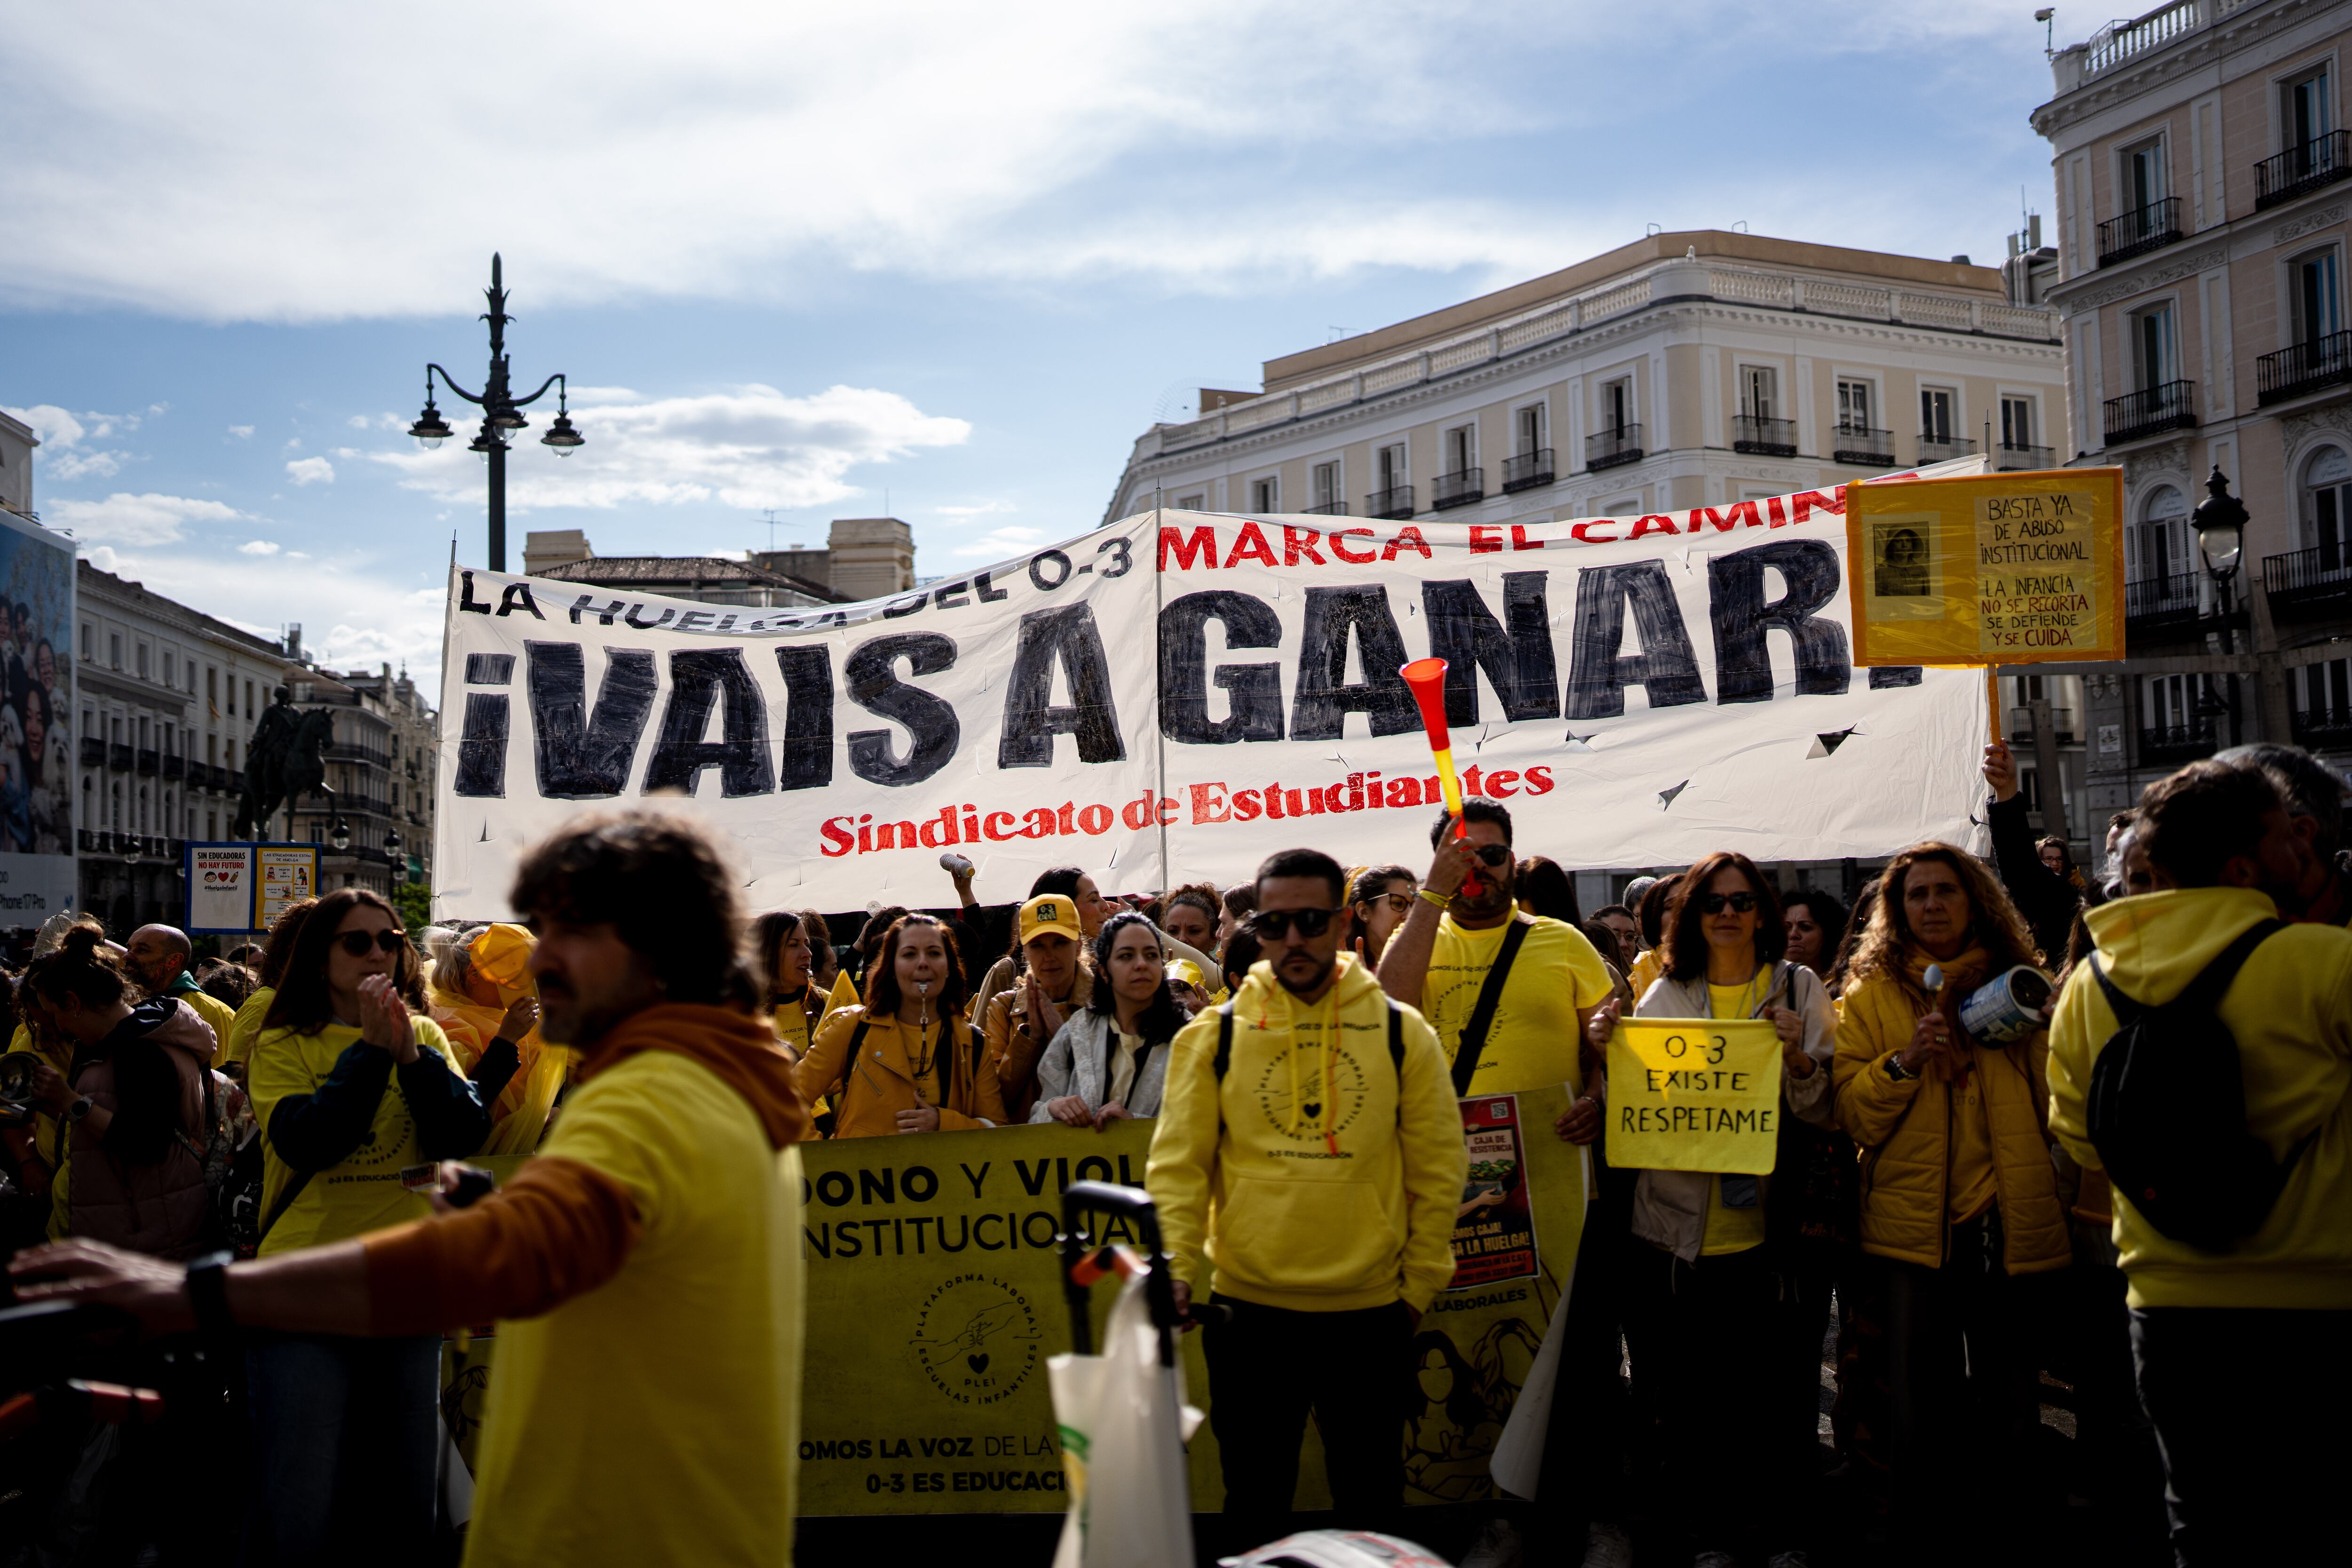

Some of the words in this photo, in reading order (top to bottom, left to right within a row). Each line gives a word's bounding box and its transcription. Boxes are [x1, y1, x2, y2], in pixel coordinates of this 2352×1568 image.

[1988, 497, 2043, 520] BASTA
[2050, 494, 2073, 516] YA
[1156, 522, 1432, 573] MARCA
[1469, 525, 1545, 554] EL
[1571, 472, 1919, 544] CAMIN
[1995, 523, 2011, 541] DE
[2018, 519, 2065, 538] ABUSO
[460, 570, 547, 621] LA
[882, 571, 1008, 620] DEL
[1986, 580, 2006, 597] LA
[1982, 599, 2001, 615] NO
[2006, 598, 2023, 613] SE
[2028, 594, 2089, 613] RECORTA
[1986, 613, 2004, 629] SE
[2011, 613, 2079, 628] DEFIENDE
[2004, 632, 2020, 646] SE
[2025, 626, 2073, 647] CUIDA
[453, 630, 961, 800] ¡VAIS
[997, 599, 1127, 770] A
[1157, 538, 1923, 745] GANAR
[820, 801, 1114, 858] Sindicato
[1121, 789, 1181, 831] de
[1189, 764, 1555, 825] Estudiantes
[1665, 1035, 1727, 1064] 0-3
[1647, 1069, 1750, 1092] EXISTE
[1621, 1106, 1774, 1134] RESPETAME
[1470, 1143, 1513, 1154] RESISTENCIA
[1474, 1136, 1494, 1145] CAJA
[1496, 1135, 1506, 1144] DE
[800, 1166, 938, 1207] ONO
[960, 1162, 991, 1199] Y
[1476, 1221, 1503, 1236] CAJA!
[1465, 1239, 1482, 1255] LA
[1483, 1231, 1532, 1253] HUELGA!
[916, 1274, 985, 1337] PLATAFORMA
[993, 1278, 1038, 1335] LABORAL
[1434, 1289, 1527, 1313] LABORALES
[919, 1347, 970, 1404] ESCUELAS
[978, 1344, 1038, 1405] INFANTILES
[964, 1377, 997, 1388] PLEI
[880, 1439, 913, 1458] LA
[919, 1437, 974, 1457] VOZ
[985, 1436, 1017, 1456] DE
[1023, 1435, 1053, 1456] LA
[866, 1473, 905, 1494] 0-3
[913, 1473, 945, 1492] ES
